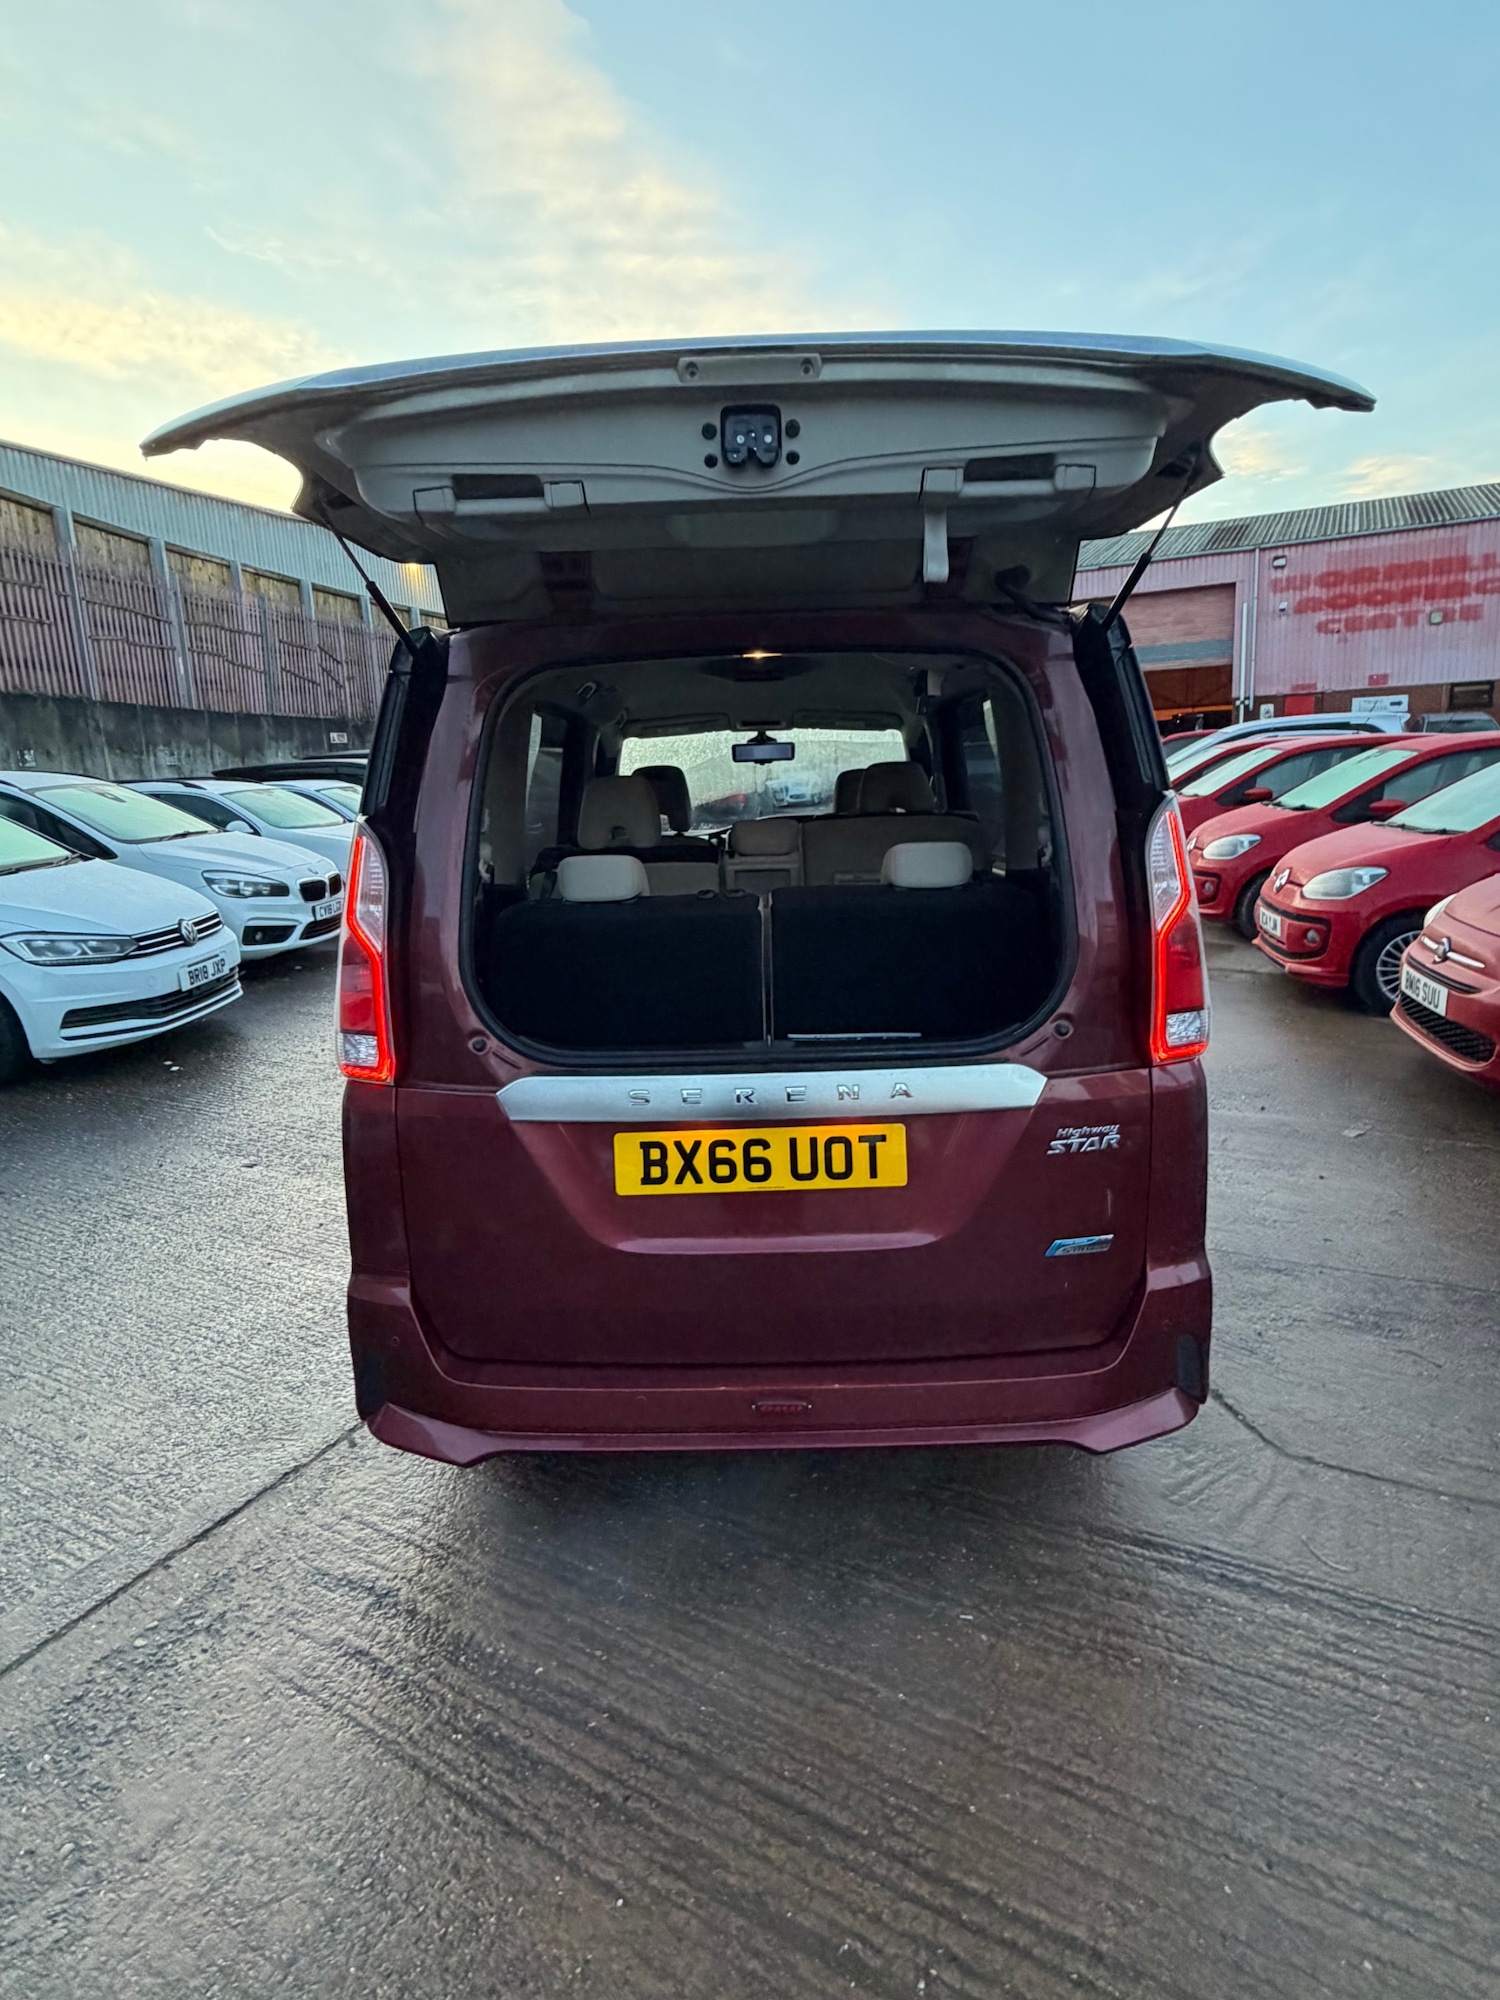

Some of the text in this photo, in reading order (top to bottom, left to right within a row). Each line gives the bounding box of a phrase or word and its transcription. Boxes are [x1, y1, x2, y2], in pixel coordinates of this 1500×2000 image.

[187, 958, 226, 986] BR18 JXP
[1421, 981, 1441, 1010] SUU
[628, 1083, 914, 1106] SERENA
[1046, 1134, 1121, 1155] STAR
[639, 1134, 888, 1187] BX66 UOT
